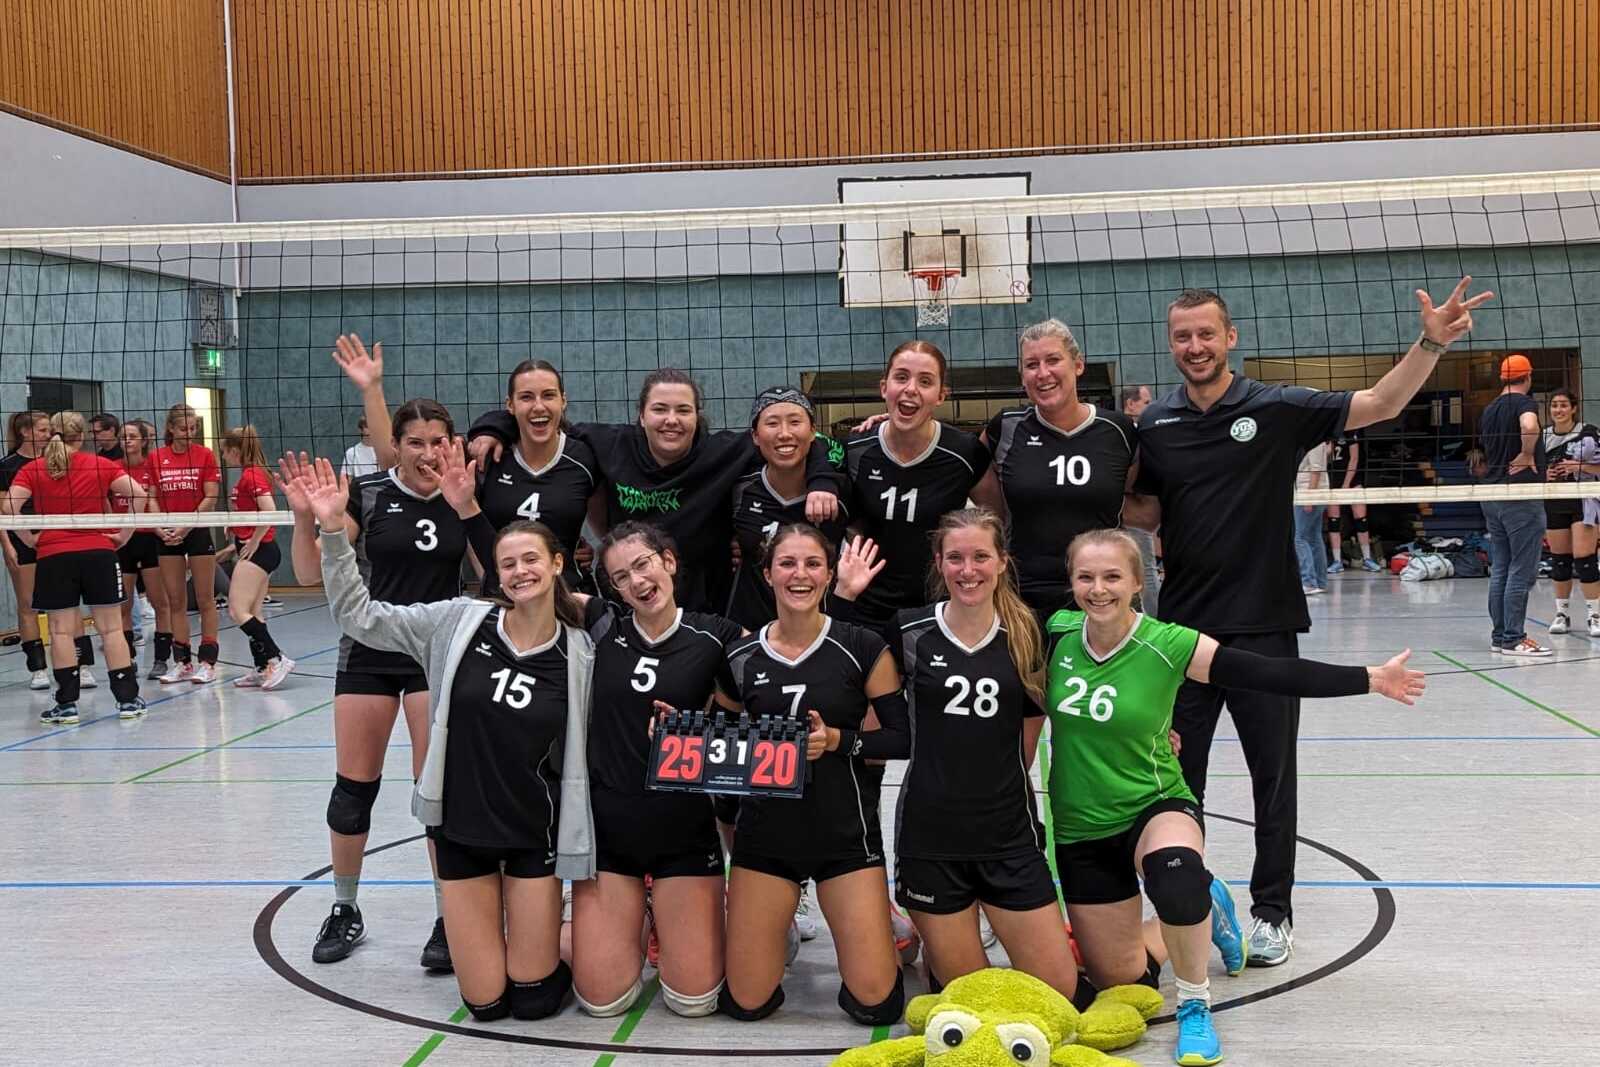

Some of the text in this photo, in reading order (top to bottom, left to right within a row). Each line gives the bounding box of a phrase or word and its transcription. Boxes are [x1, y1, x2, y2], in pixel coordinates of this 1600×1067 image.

[1049, 455, 1091, 486] 10
[517, 492, 540, 521] 4
[880, 486, 918, 522] 11
[415, 519, 438, 551] 3
[490, 668, 536, 709] 15
[630, 656, 660, 692] 5
[782, 684, 807, 717] 7
[943, 675, 999, 718] 28
[1057, 676, 1117, 722] 26
[658, 735, 797, 786] 25 3 1 20
